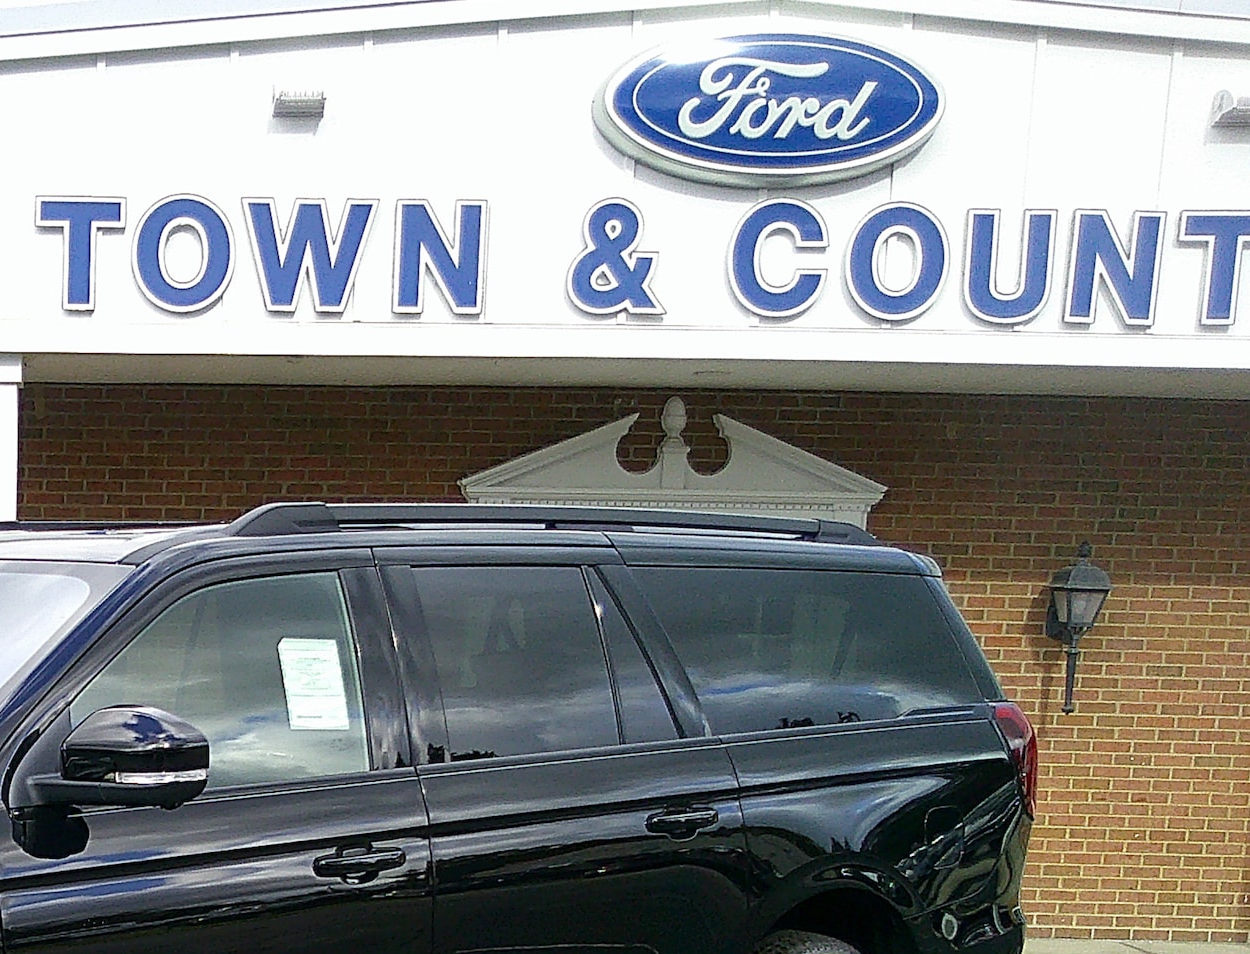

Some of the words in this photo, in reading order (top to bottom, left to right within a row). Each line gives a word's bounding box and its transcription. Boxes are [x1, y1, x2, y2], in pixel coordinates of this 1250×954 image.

[678, 56, 877, 140] Ford
[36, 193, 488, 314] TOWN
[565, 196, 666, 316] &
[728, 196, 1250, 326] COUNT
